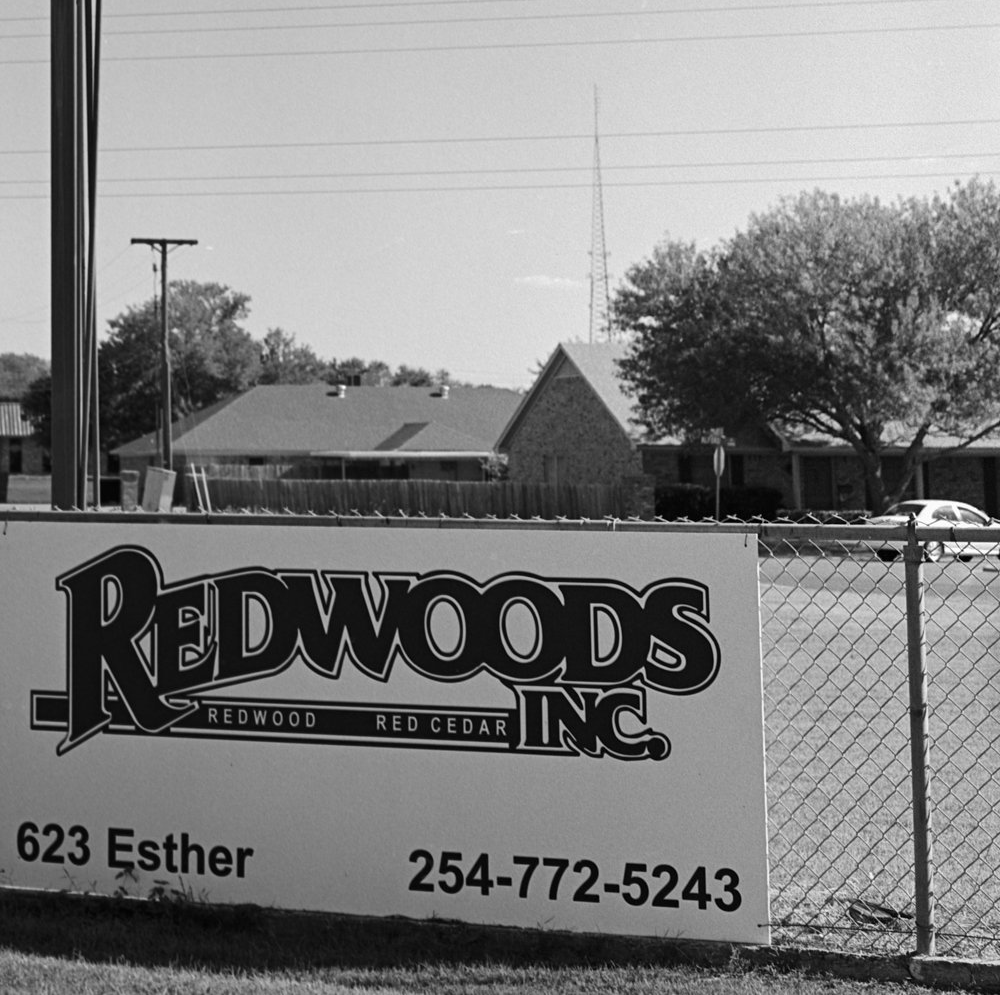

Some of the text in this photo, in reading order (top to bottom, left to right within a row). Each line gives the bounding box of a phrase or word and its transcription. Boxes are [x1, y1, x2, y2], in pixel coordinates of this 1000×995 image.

[56, 544, 722, 756] REDWOODS
[208, 707, 316, 728] REDWOOD
[376, 714, 507, 736] RED CEDAR
[512, 680, 672, 761] INC.
[16, 821, 255, 879] 623 Esther
[408, 849, 742, 913] 254-772-5243
